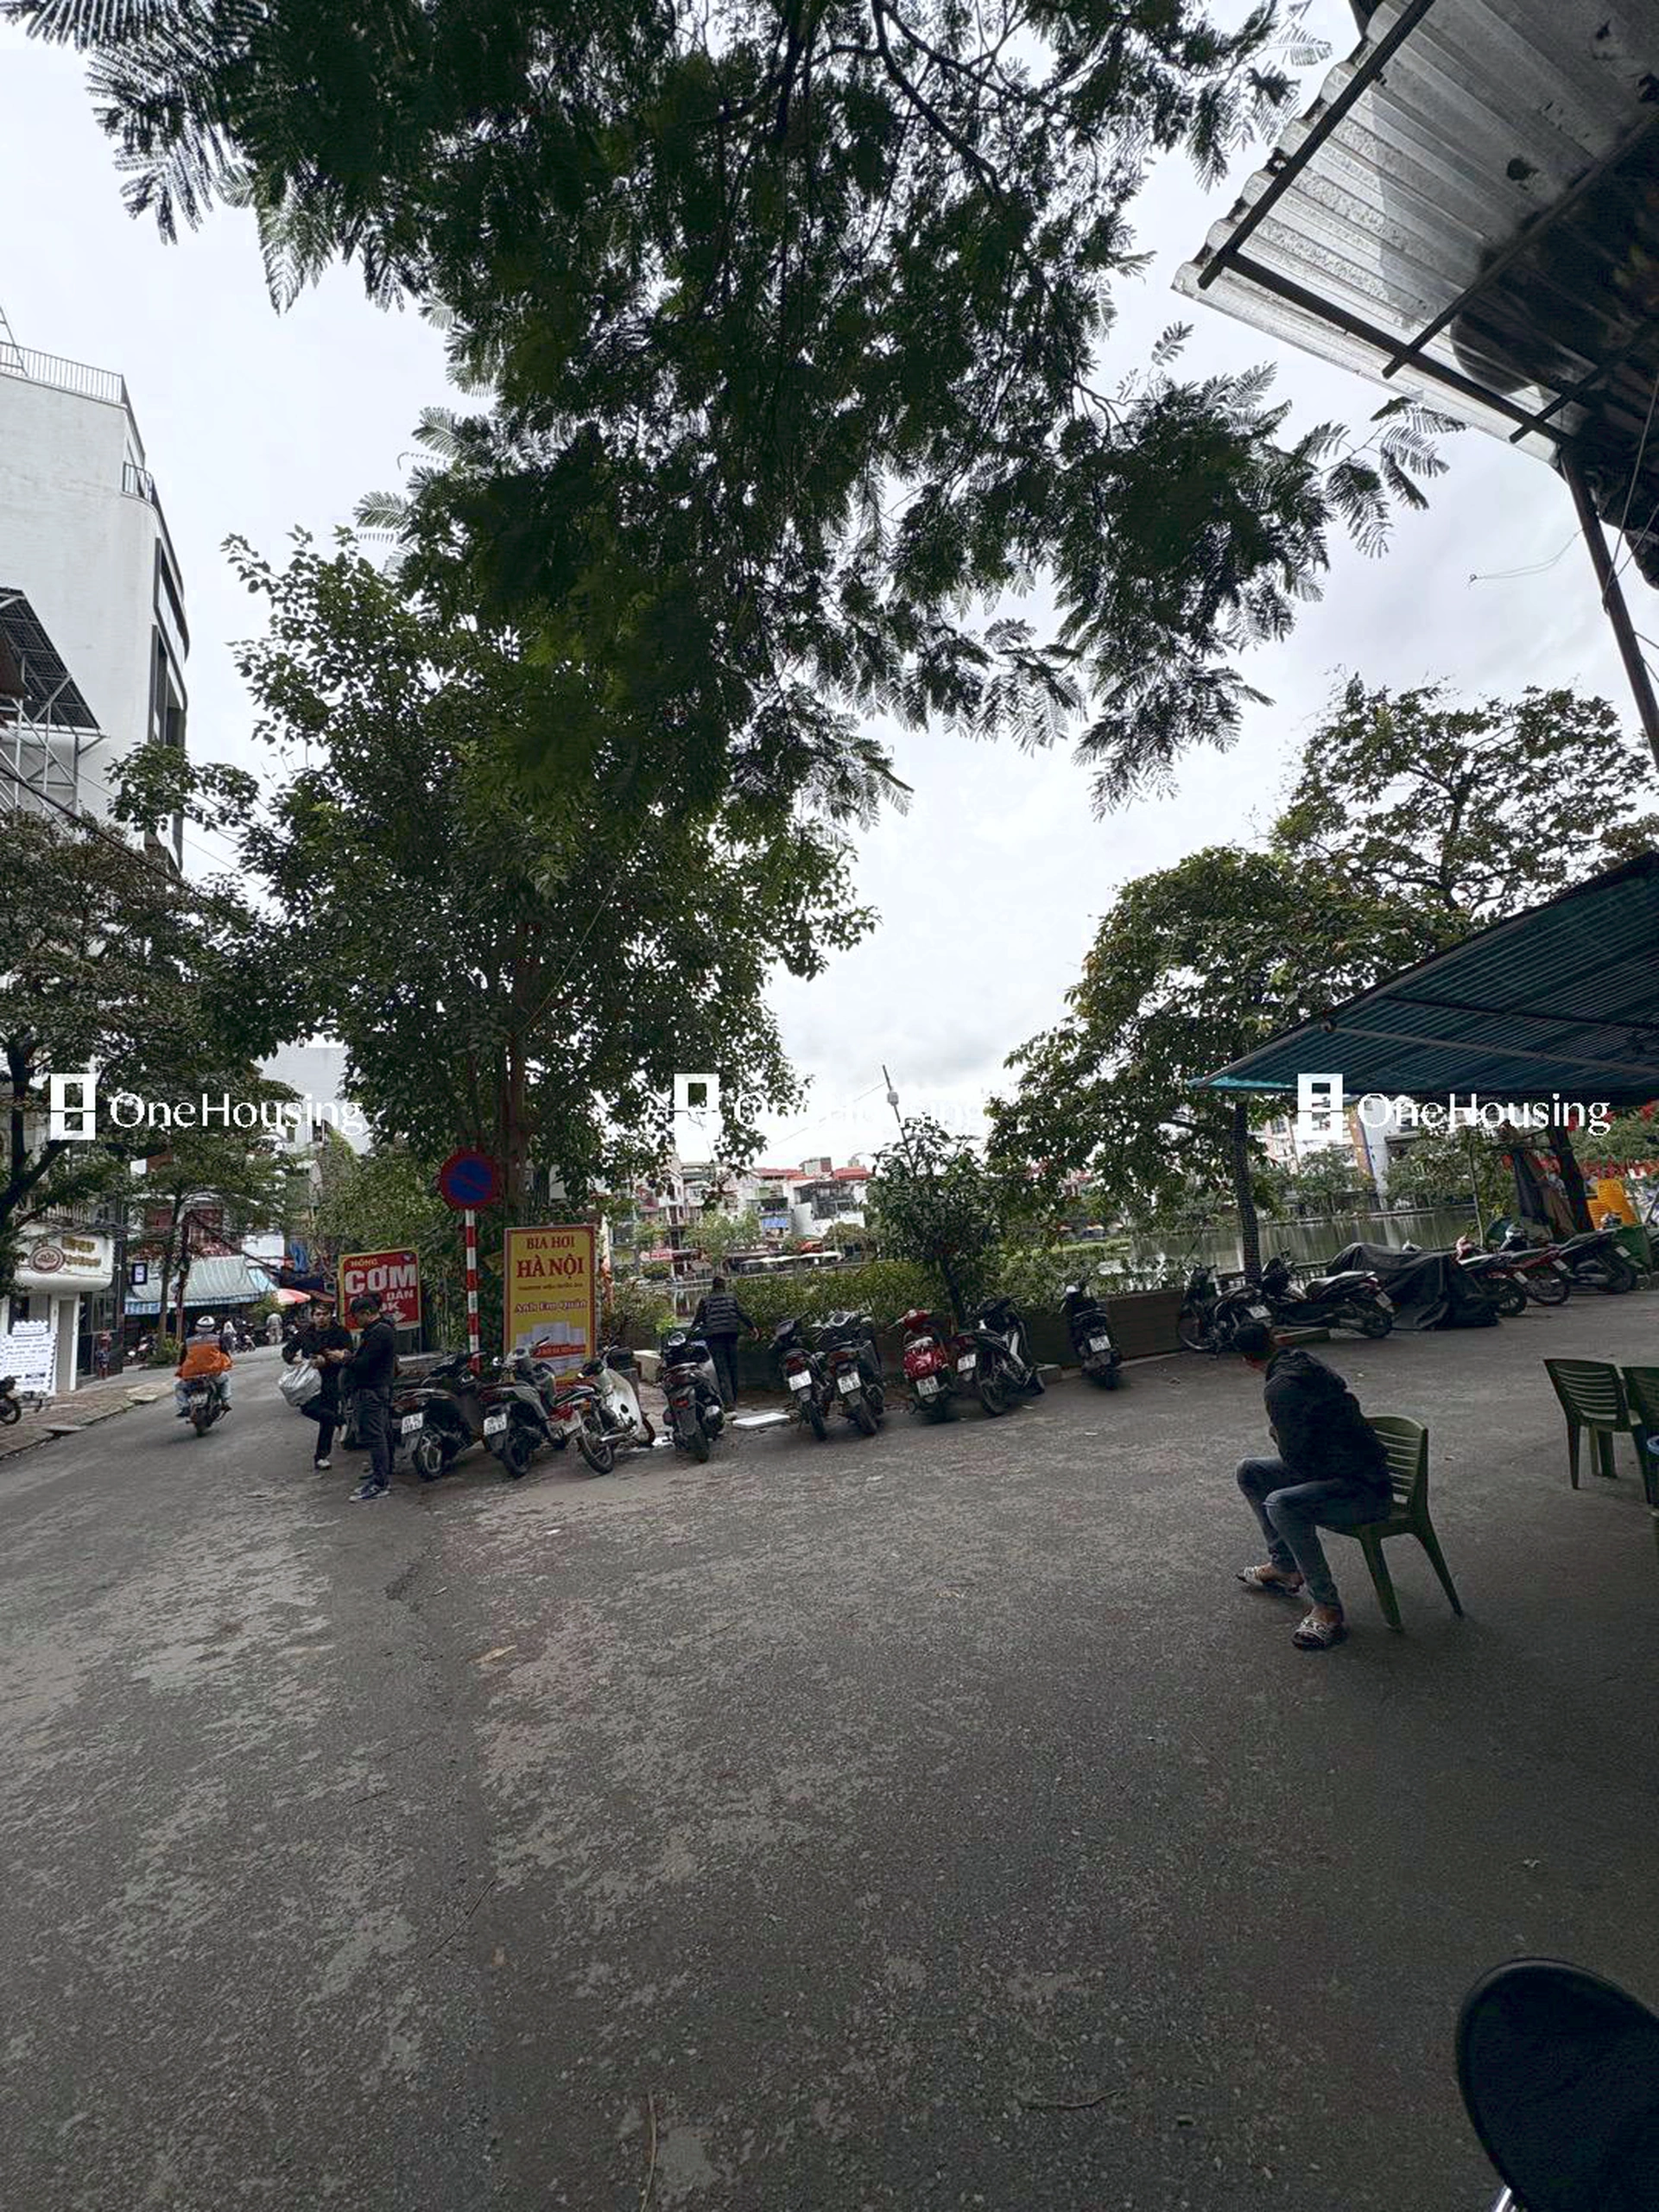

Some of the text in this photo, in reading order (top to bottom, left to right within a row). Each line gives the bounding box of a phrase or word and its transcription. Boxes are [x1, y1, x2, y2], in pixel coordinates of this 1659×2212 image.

[527, 1237, 548, 1249] BIA
[345, 1264, 416, 1294] CƠM
[516, 1253, 585, 1279] HÀ NỘI
